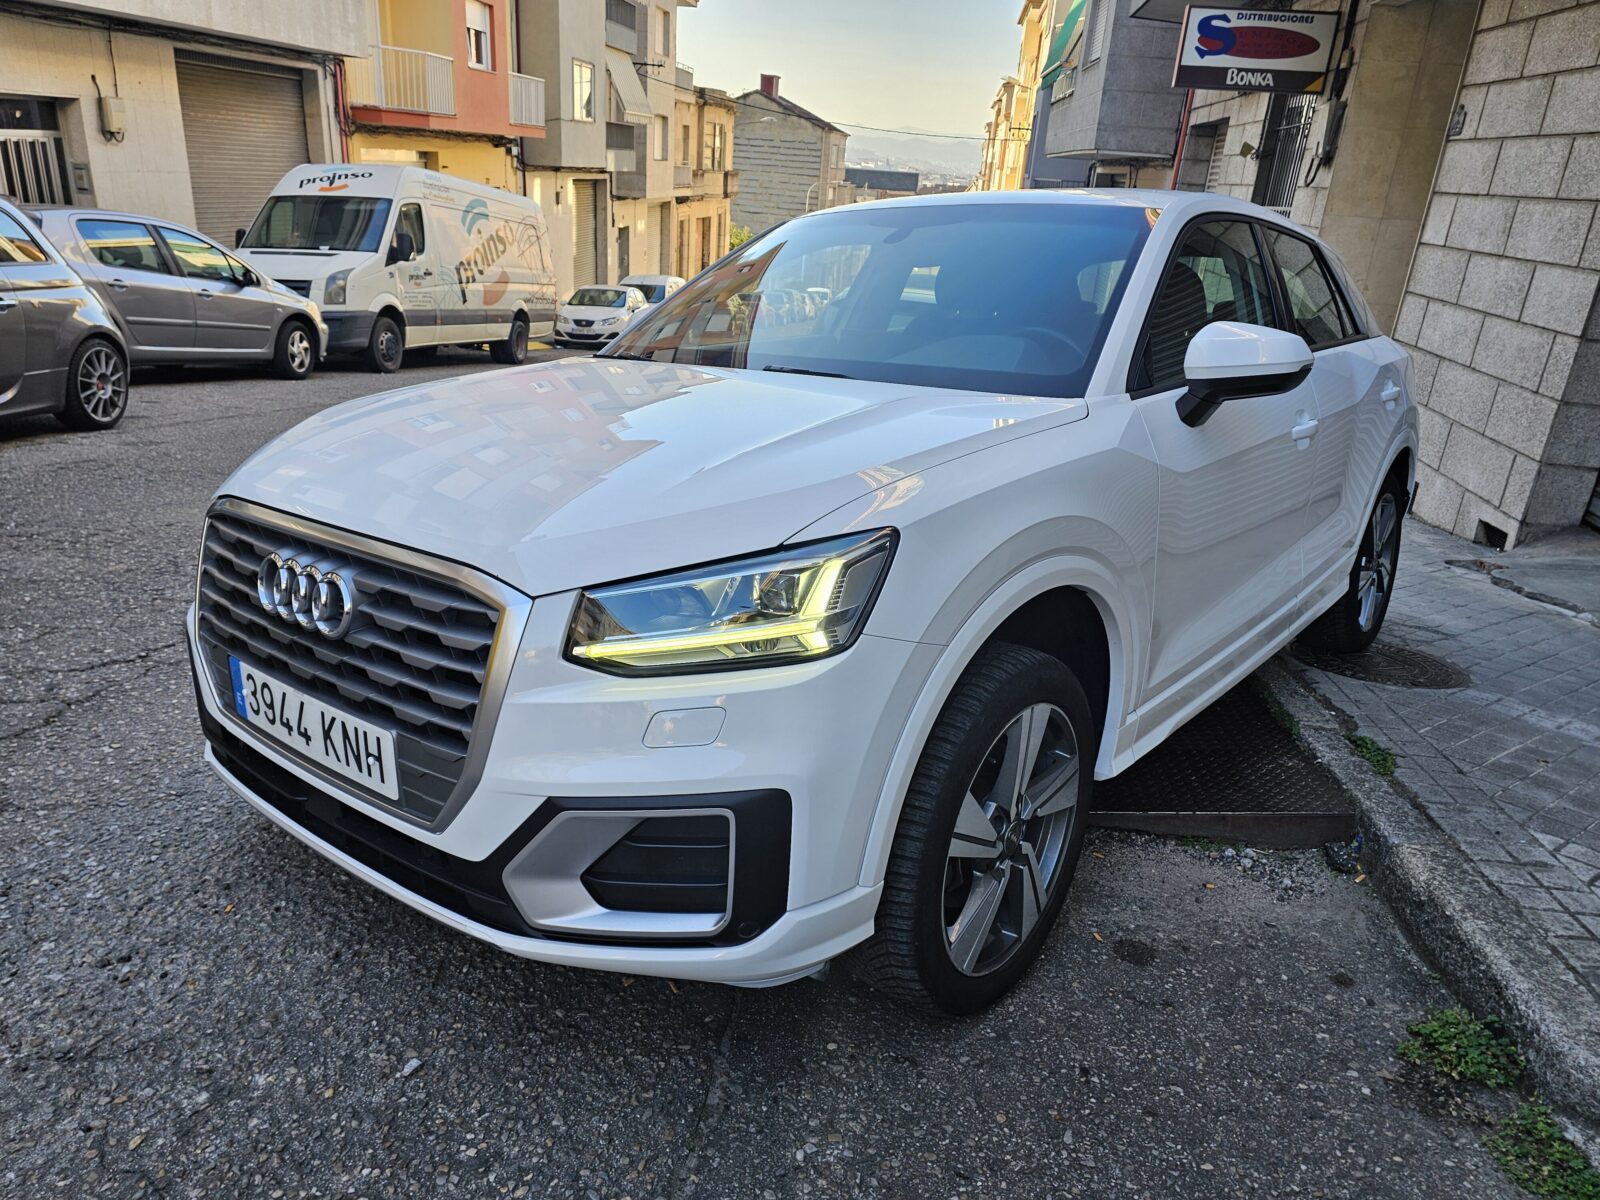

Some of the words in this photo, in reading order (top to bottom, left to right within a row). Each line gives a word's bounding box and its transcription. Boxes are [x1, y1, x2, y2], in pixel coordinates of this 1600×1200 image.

[1236, 12, 1315, 24] DISTRIBUCIONES
[298, 172, 373, 189] proinso
[455, 220, 515, 305] proinso
[246, 673, 312, 747] 3944
[320, 710, 386, 785] KNH
